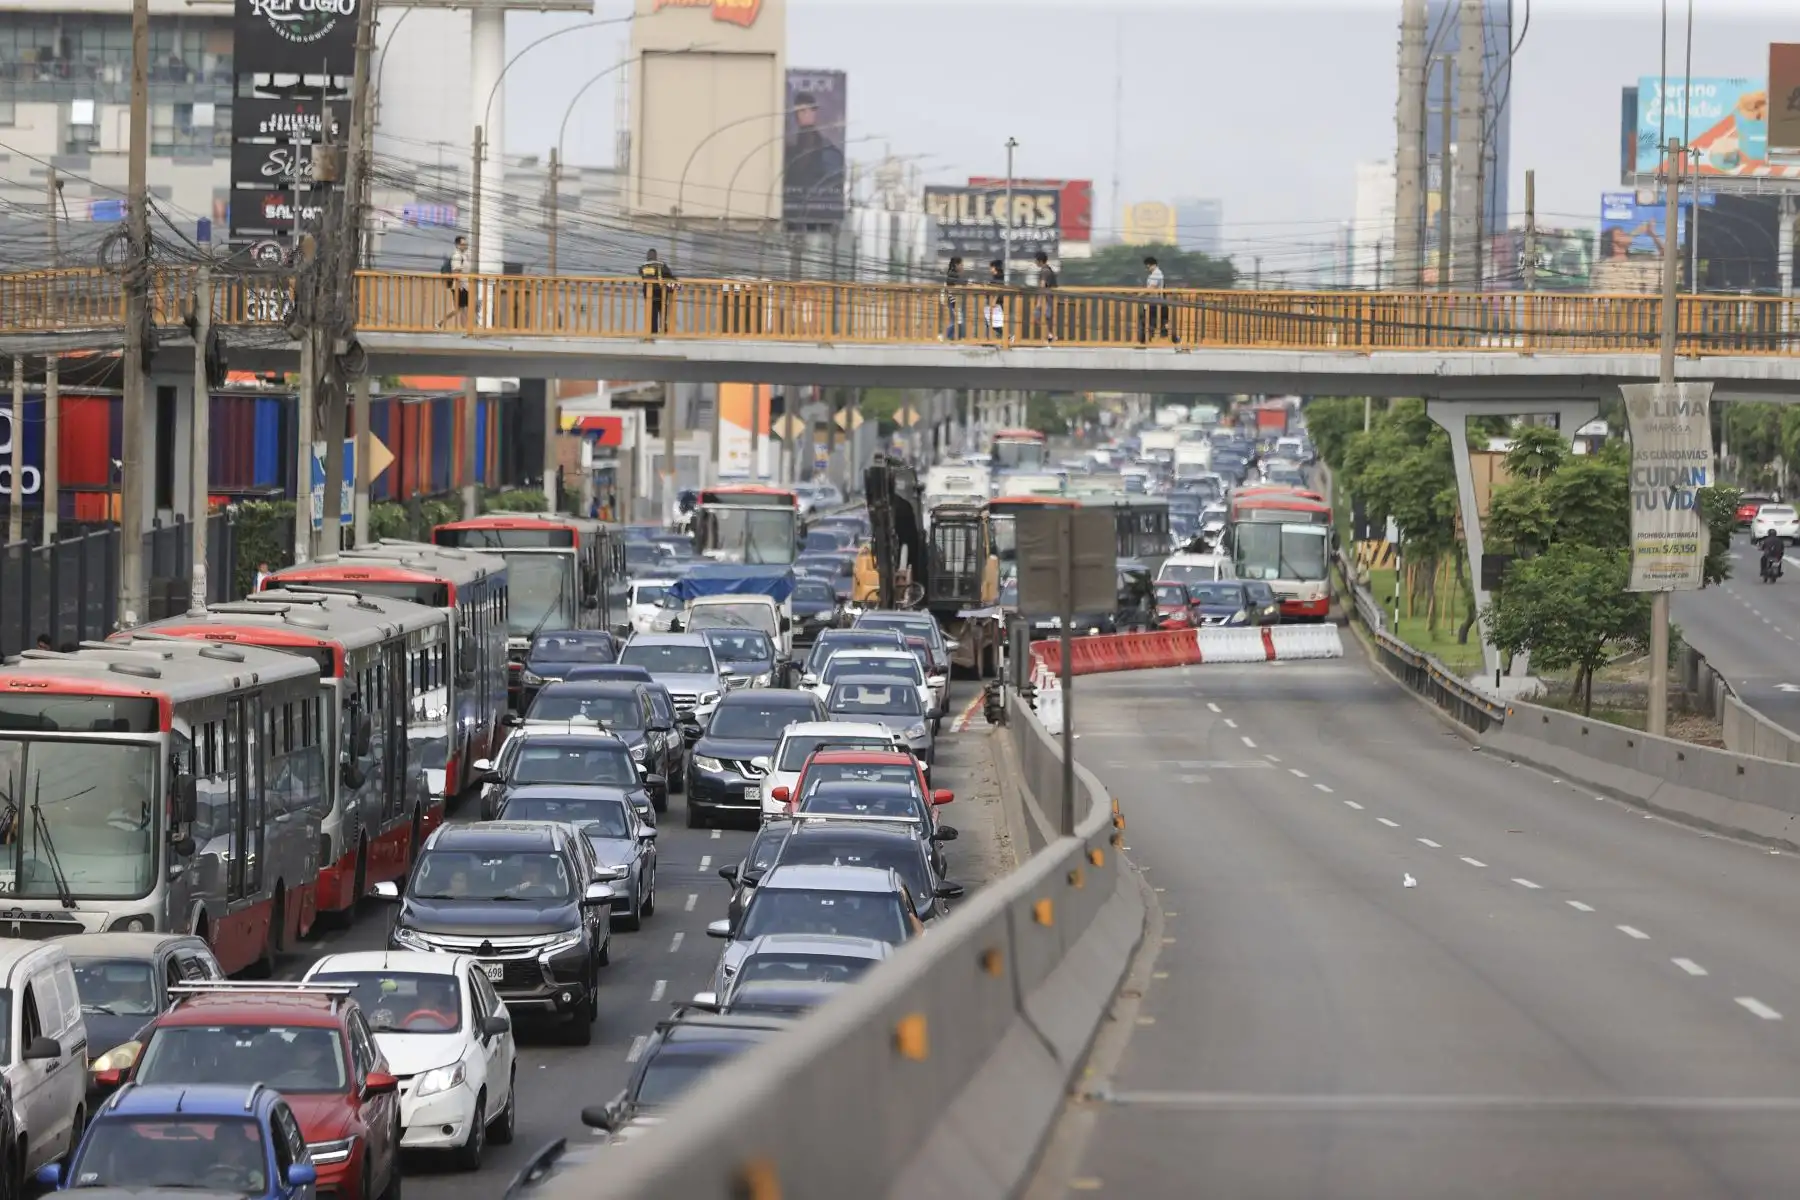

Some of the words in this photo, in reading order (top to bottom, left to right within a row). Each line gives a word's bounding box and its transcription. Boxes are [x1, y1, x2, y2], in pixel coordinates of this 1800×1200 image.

[1653, 401, 1705, 417] LIMA
[1632, 466, 1706, 487] CUIDAN
[1631, 490, 1658, 510] TU
